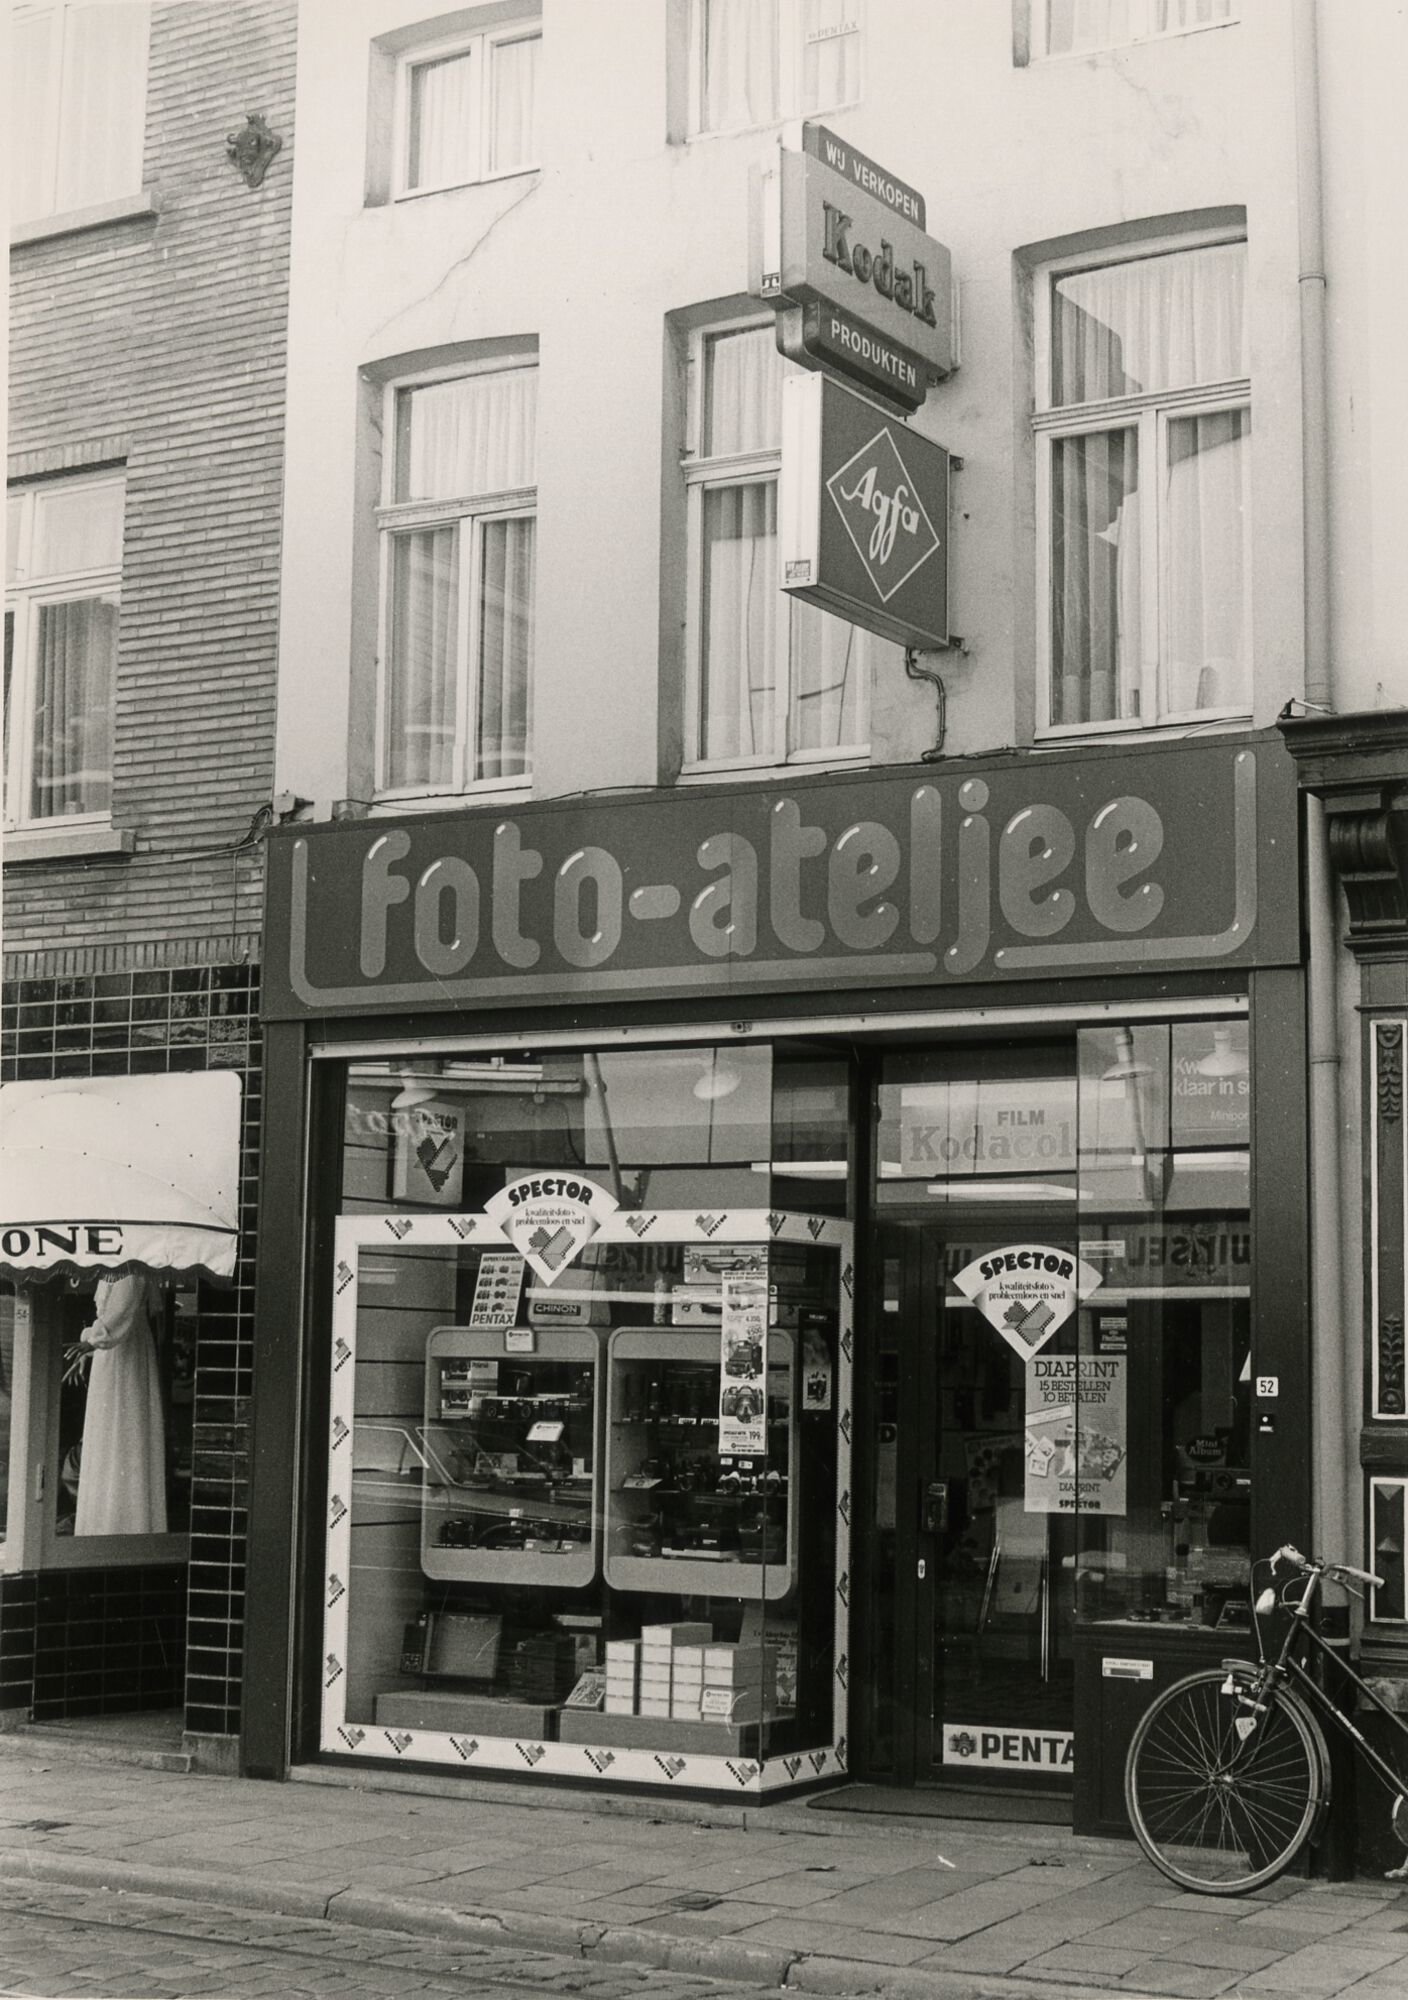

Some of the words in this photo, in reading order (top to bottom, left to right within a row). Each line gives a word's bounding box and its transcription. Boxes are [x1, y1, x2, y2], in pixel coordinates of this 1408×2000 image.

[826, 140, 846, 171] WIJ
[853, 158, 919, 220] VERKOPEN
[822, 200, 937, 329] Kodak
[831, 319, 916, 387] PRODUKTEN
[840, 466, 920, 566] Agfa
[359, 777, 1165, 977] foto-ateljee
[997, 1109, 1045, 1126] FILM
[508, 1178, 593, 1207] SPECTOR
[1, 1226, 124, 1257] ONE
[979, 1251, 1074, 1281] SPECTOR
[535, 1303, 578, 1315] CHINON
[988, 1291, 1038, 1302] probleemloos
[472, 1313, 515, 1326] PENTAX
[1034, 1361, 1120, 1378] DIAPRINT
[1039, 1380, 1050, 1392] 15
[1051, 1380, 1111, 1392] BESTELLEN
[1057, 1391, 1107, 1403] BETALEN
[1260, 1380, 1275, 1394] 52
[981, 1732, 1074, 1765] PENTA
